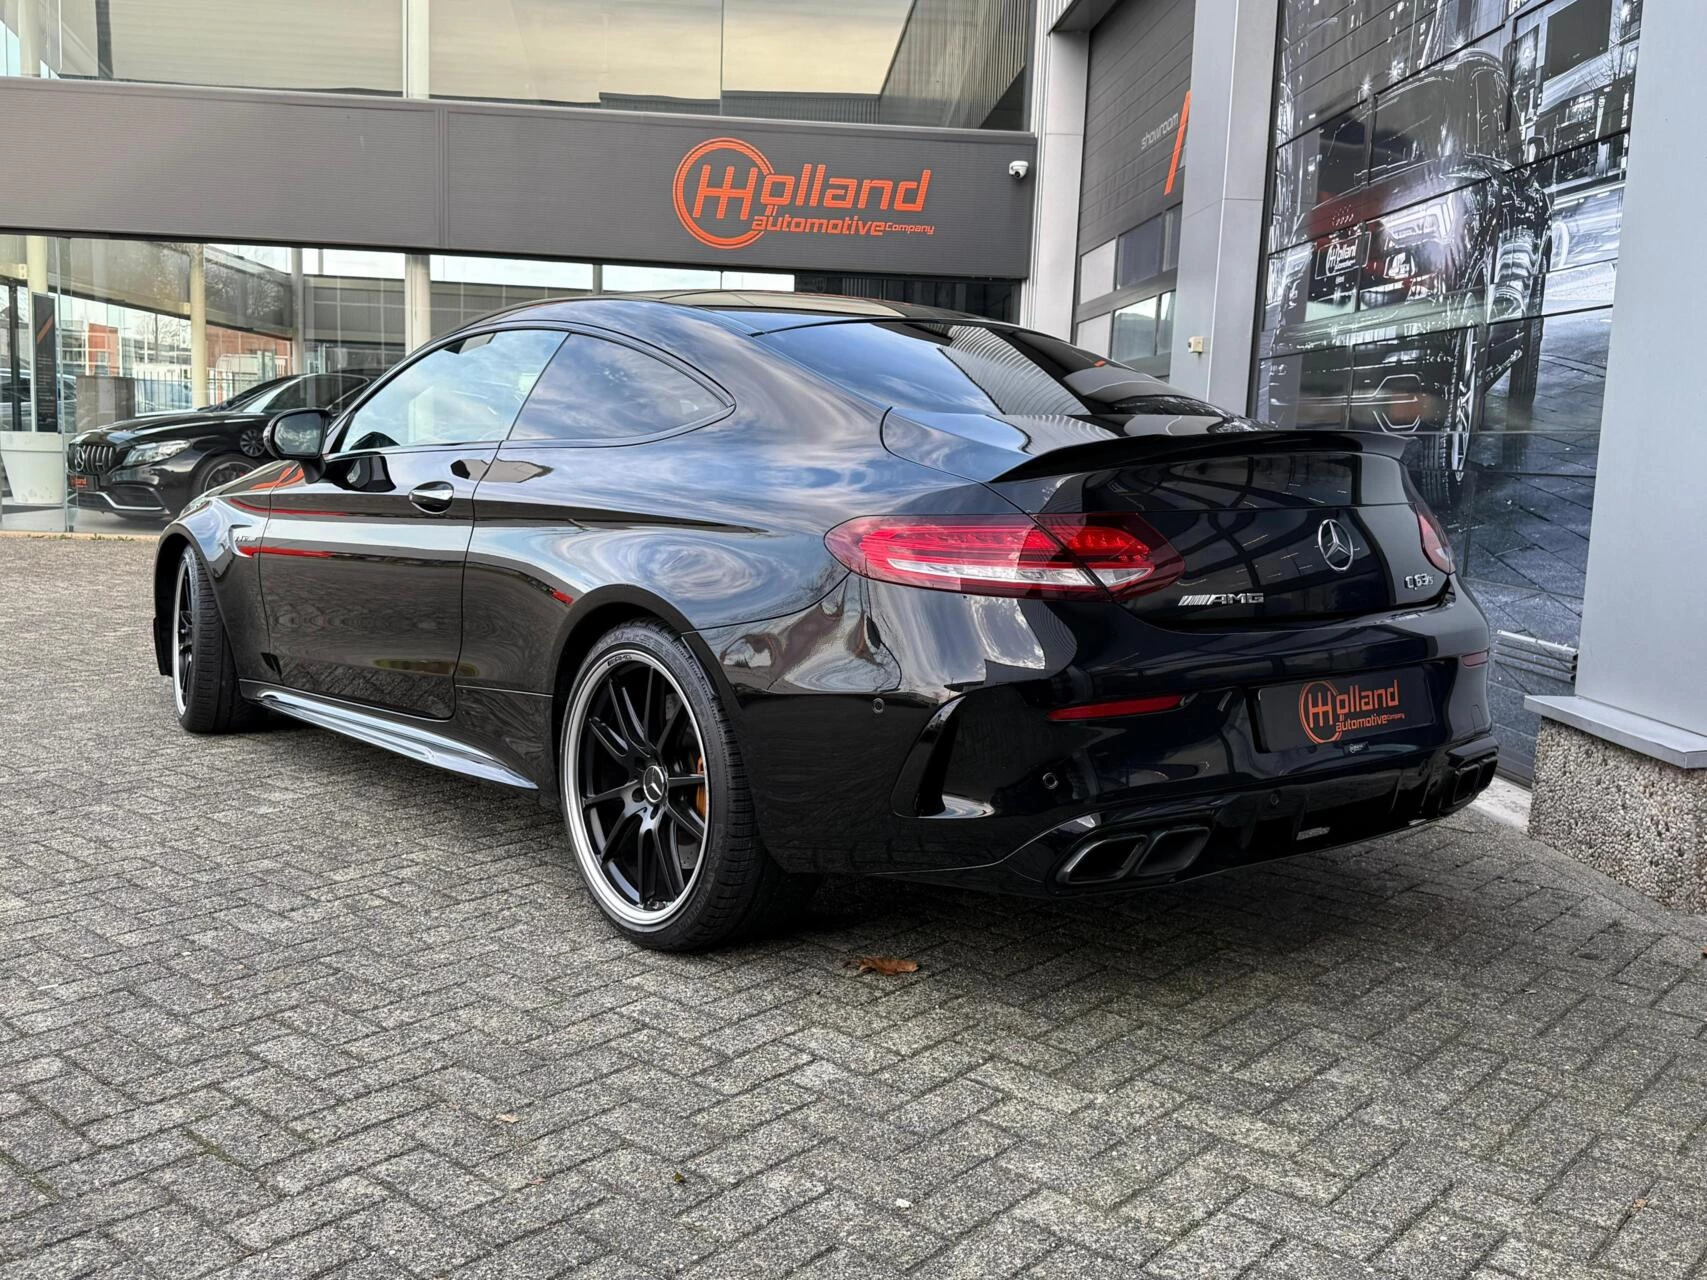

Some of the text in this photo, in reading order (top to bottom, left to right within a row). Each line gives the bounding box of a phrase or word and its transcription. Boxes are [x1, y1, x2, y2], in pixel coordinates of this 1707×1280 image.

[1141, 112, 1179, 150] showroom
[692, 163, 932, 220] Holland
[752, 214, 935, 236] automotive Company
[1206, 592, 1264, 605] AMG
[1308, 679, 1399, 729] Holland
[1336, 713, 1388, 732] automotive
